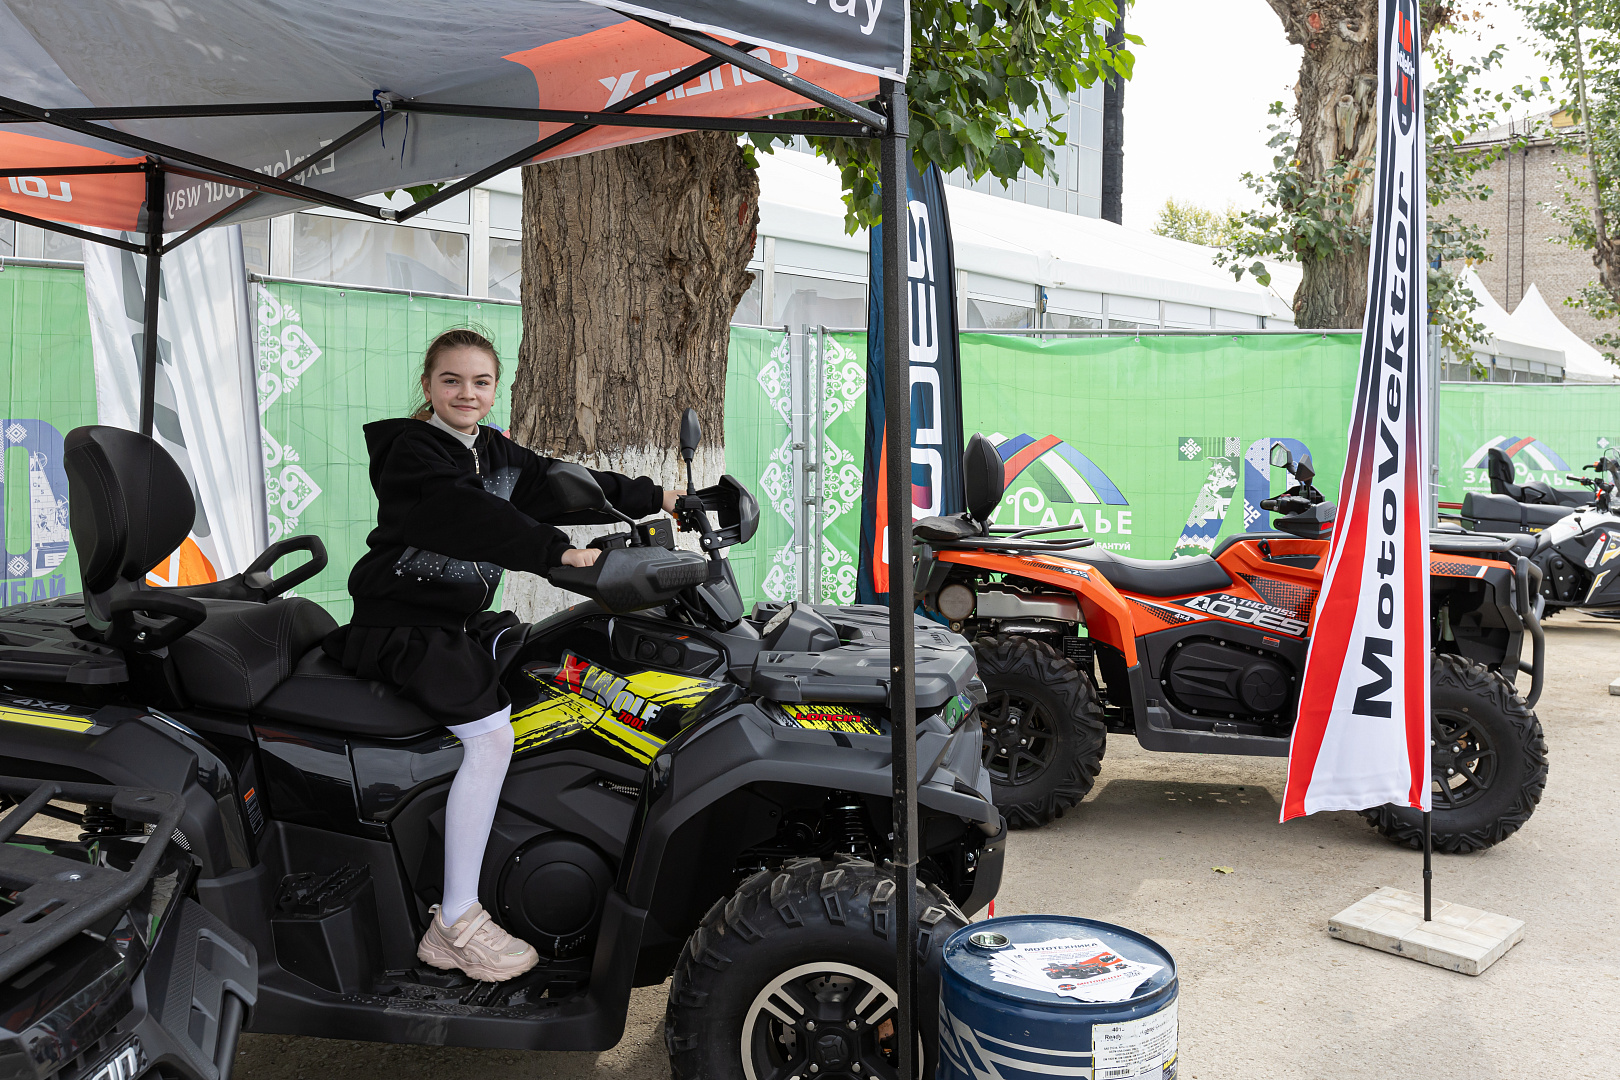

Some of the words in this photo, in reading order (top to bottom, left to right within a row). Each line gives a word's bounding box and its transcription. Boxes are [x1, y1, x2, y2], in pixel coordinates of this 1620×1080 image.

[807, 0, 884, 36] ay
[1184, 595, 1310, 637] AODES
[1218, 594, 1298, 618] PATHCROSS
